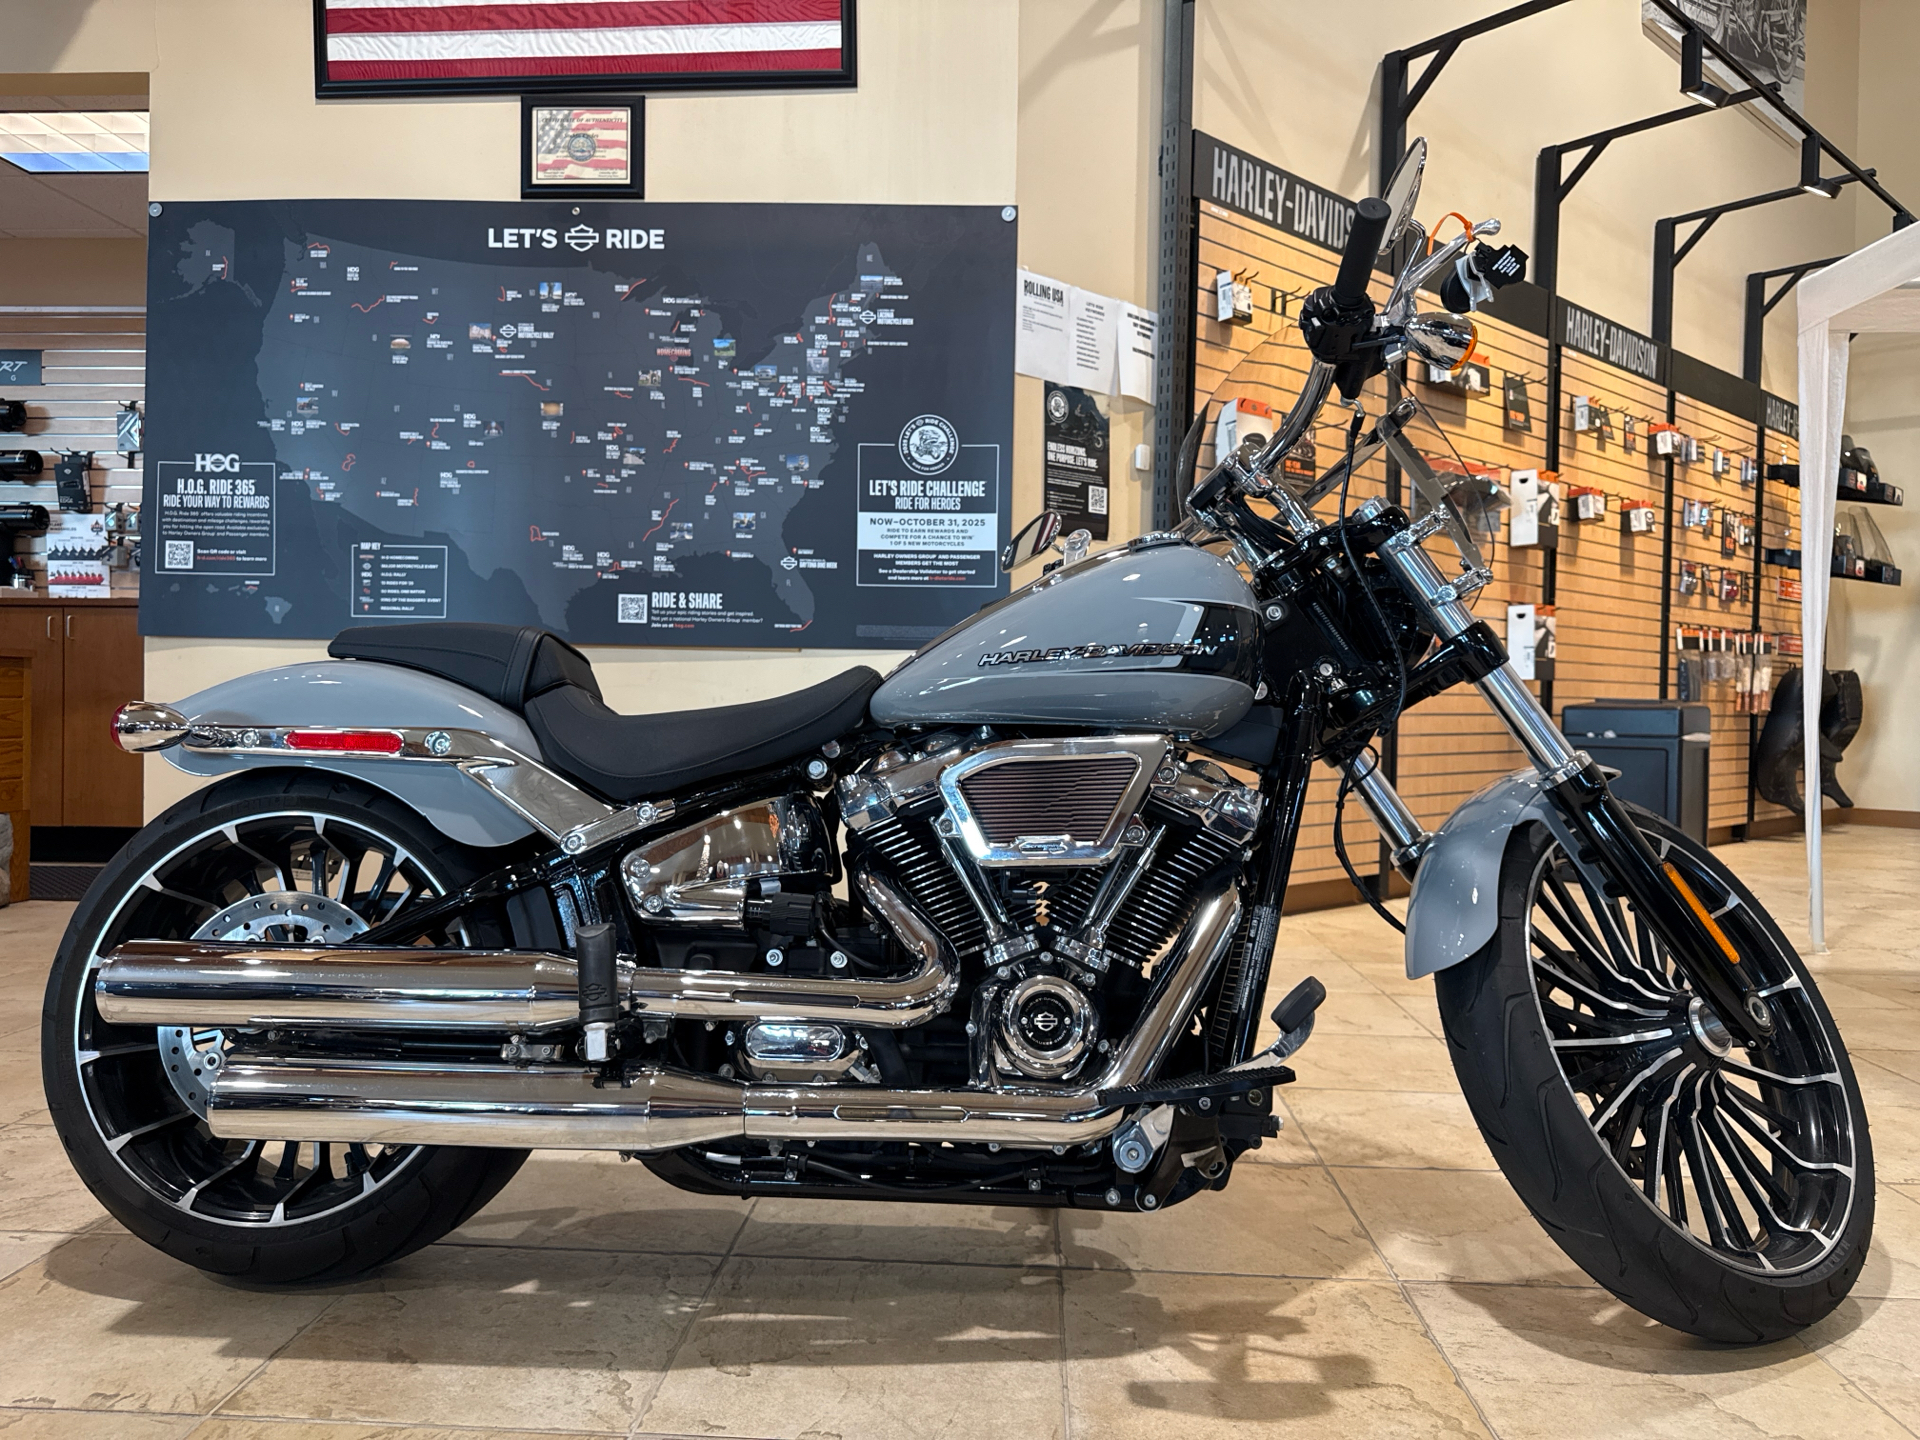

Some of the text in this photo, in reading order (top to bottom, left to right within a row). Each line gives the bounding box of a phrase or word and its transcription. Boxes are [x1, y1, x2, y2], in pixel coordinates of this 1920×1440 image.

[488, 228, 665, 249] LET'S RIDE
[1024, 280, 1051, 300] ROLLING
[1052, 288, 1064, 306] USA
[1566, 306, 1658, 380] HARLEY-DAVIDSON
[177, 478, 207, 494] H.O.G.
[210, 479, 233, 494] RIDE
[869, 480, 986, 497] LET'S RIDE CHALLENGE
[163, 494, 269, 509] RIDE YOUR WAY TO REWARDS
[895, 497, 961, 510] RIDE FOR HEROES
[947, 519, 960, 527] 31,
[651, 592, 723, 609] RIDE & SHARE
[978, 642, 1219, 666] HARLEY-DAVIDSON
